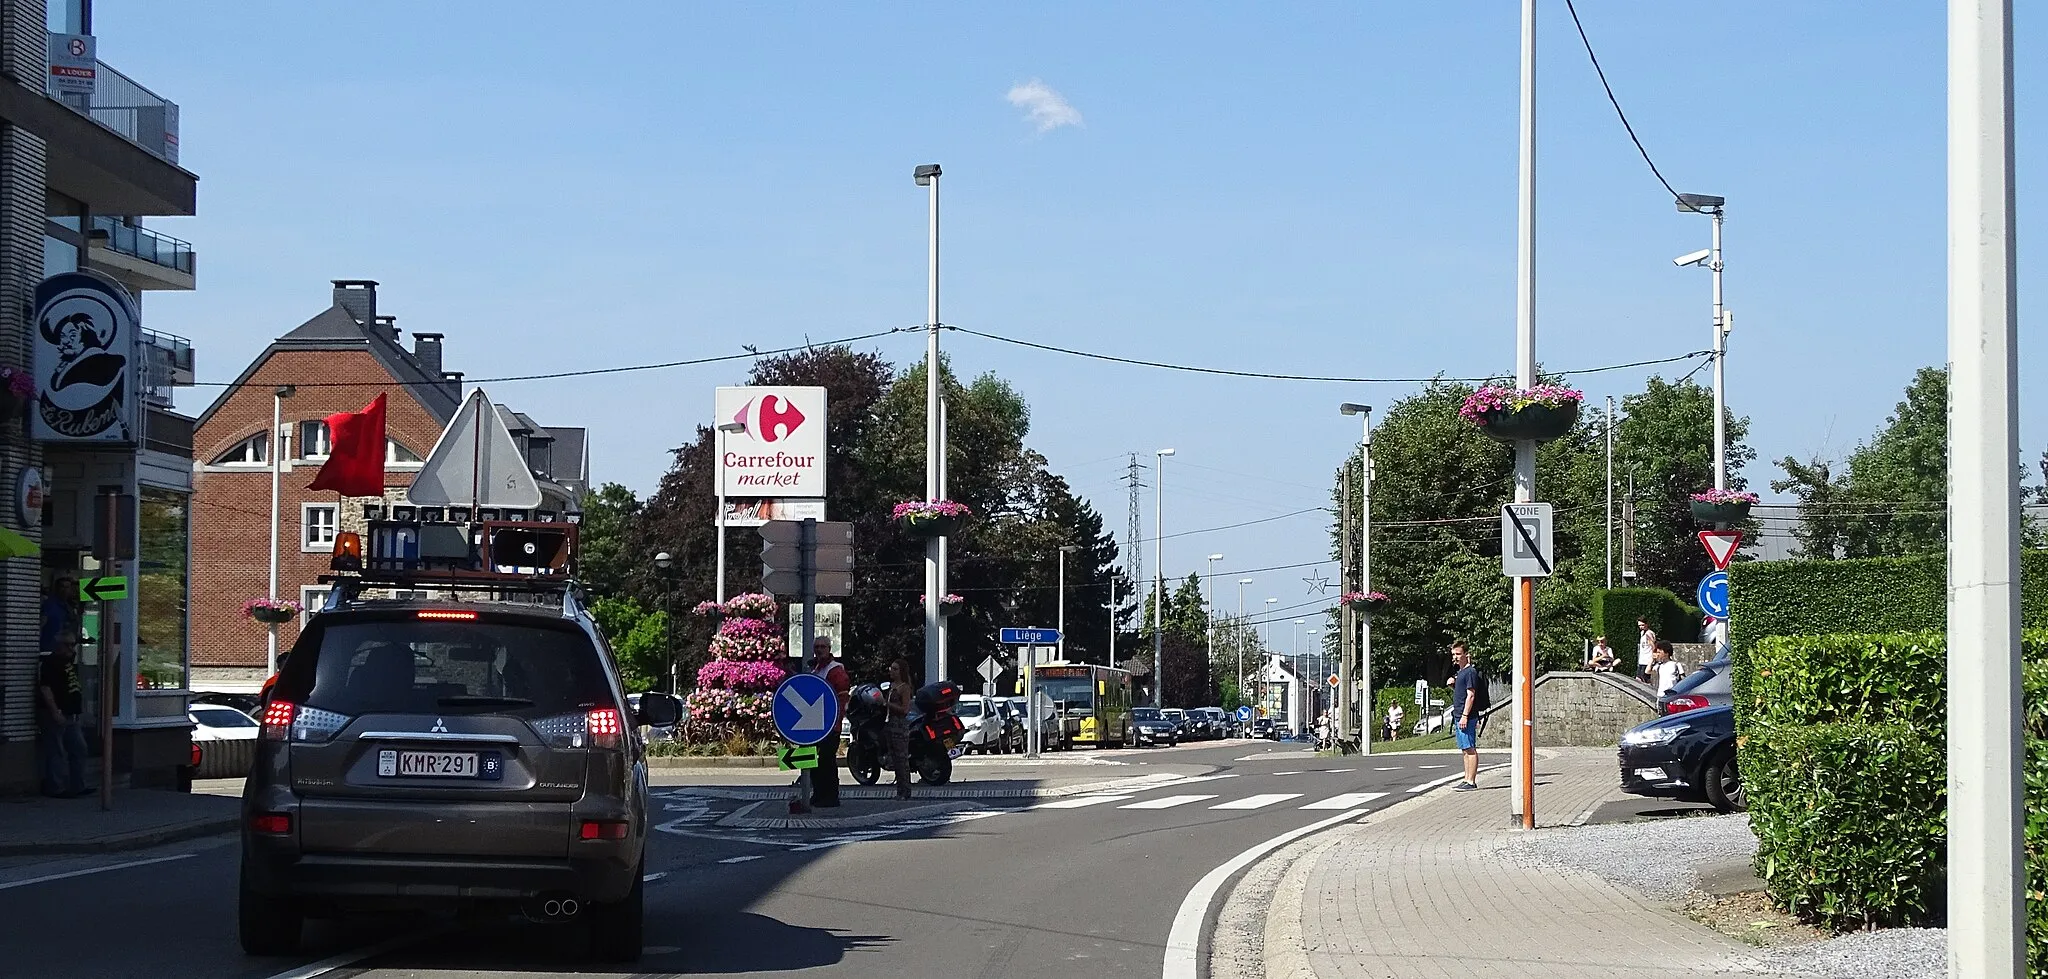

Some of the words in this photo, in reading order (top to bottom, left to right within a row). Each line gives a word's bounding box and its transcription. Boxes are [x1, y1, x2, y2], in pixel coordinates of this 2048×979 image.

[67, 69, 92, 77] LOUER
[724, 452, 815, 468] Carrefour
[738, 471, 800, 487] market
[1514, 507, 1539, 516] ZONE
[1016, 630, 1041, 642] Liège
[402, 754, 474, 774] KMR-291
[486, 761, 495, 770] B
